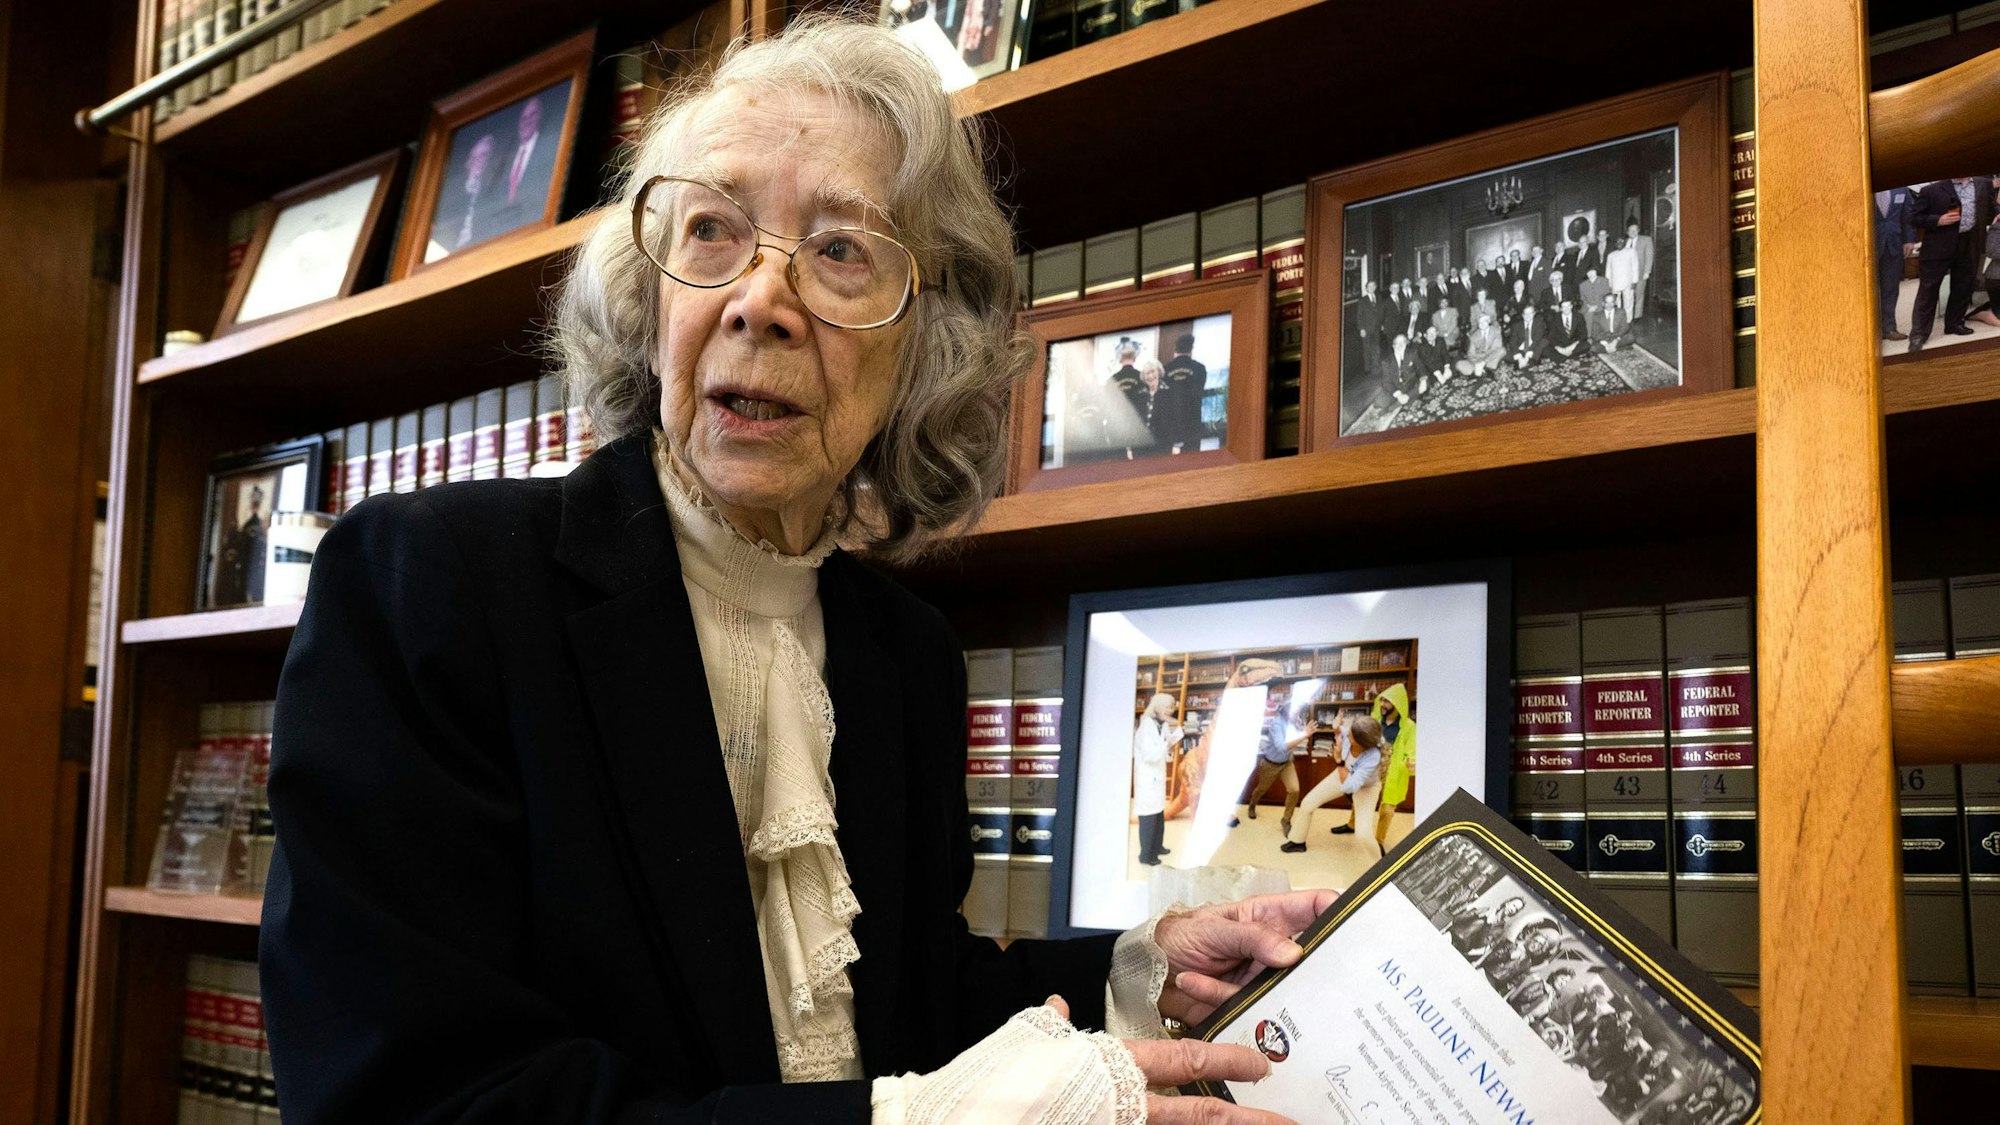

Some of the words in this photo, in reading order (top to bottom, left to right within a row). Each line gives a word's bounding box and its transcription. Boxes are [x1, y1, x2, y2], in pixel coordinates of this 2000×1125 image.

[1272, 254, 1303, 269] FEDERA
[1277, 268, 1303, 282] PORTE
[1597, 690, 1648, 703] FEDERAL
[1683, 685, 1736, 700] FEDERAL
[1521, 694, 1568, 707] FEDERAL
[1518, 711, 1572, 725] REPORTER
[1594, 707, 1652, 721] REPORTER
[1680, 703, 1740, 719] REPORTER
[973, 714, 1004, 724] FEDERAL
[1021, 713, 1054, 724] FEDERAL
[971, 728, 1006, 738] REPORTER
[1019, 727, 1056, 738] REPORTER
[1520, 755, 1536, 766] 4th
[1539, 755, 1573, 767] Series
[1596, 752, 1615, 763] 4th
[1618, 751, 1653, 764] Series
[1682, 750, 1701, 762] 4th
[1704, 748, 1742, 761] Series
[983, 762, 1004, 772] Series
[1032, 762, 1054, 771] Series
[979, 781, 996, 797] 33
[1534, 781, 1560, 800] 42
[1613, 776, 1641, 796] 43
[1700, 773, 1727, 795] 44
[1451, 996, 1462, 1008] In
[1459, 1006, 1500, 1051] recognition
[1498, 1048, 1515, 1067] that
[1353, 1007, 1366, 1020] the
[1363, 1018, 1386, 1048] memory
[1383, 1047, 1402, 1063] and
[1395, 1059, 1418, 1093] history
[1416, 1087, 1431, 1100] of
[1424, 1097, 1438, 1113] the
[1374, 1000, 1387, 1016] has
[1384, 1014, 1409, 1040] played
[1403, 1037, 1414, 1049] an
[1411, 1048, 1444, 1084] essential
[1438, 1081, 1456, 1100] role
[1453, 1097, 1464, 1111] in
[1356, 1042, 1379, 1072] Women
[1376, 1069, 1401, 1103] Airforce
[1469, 1060, 1535, 1125] NEWM
